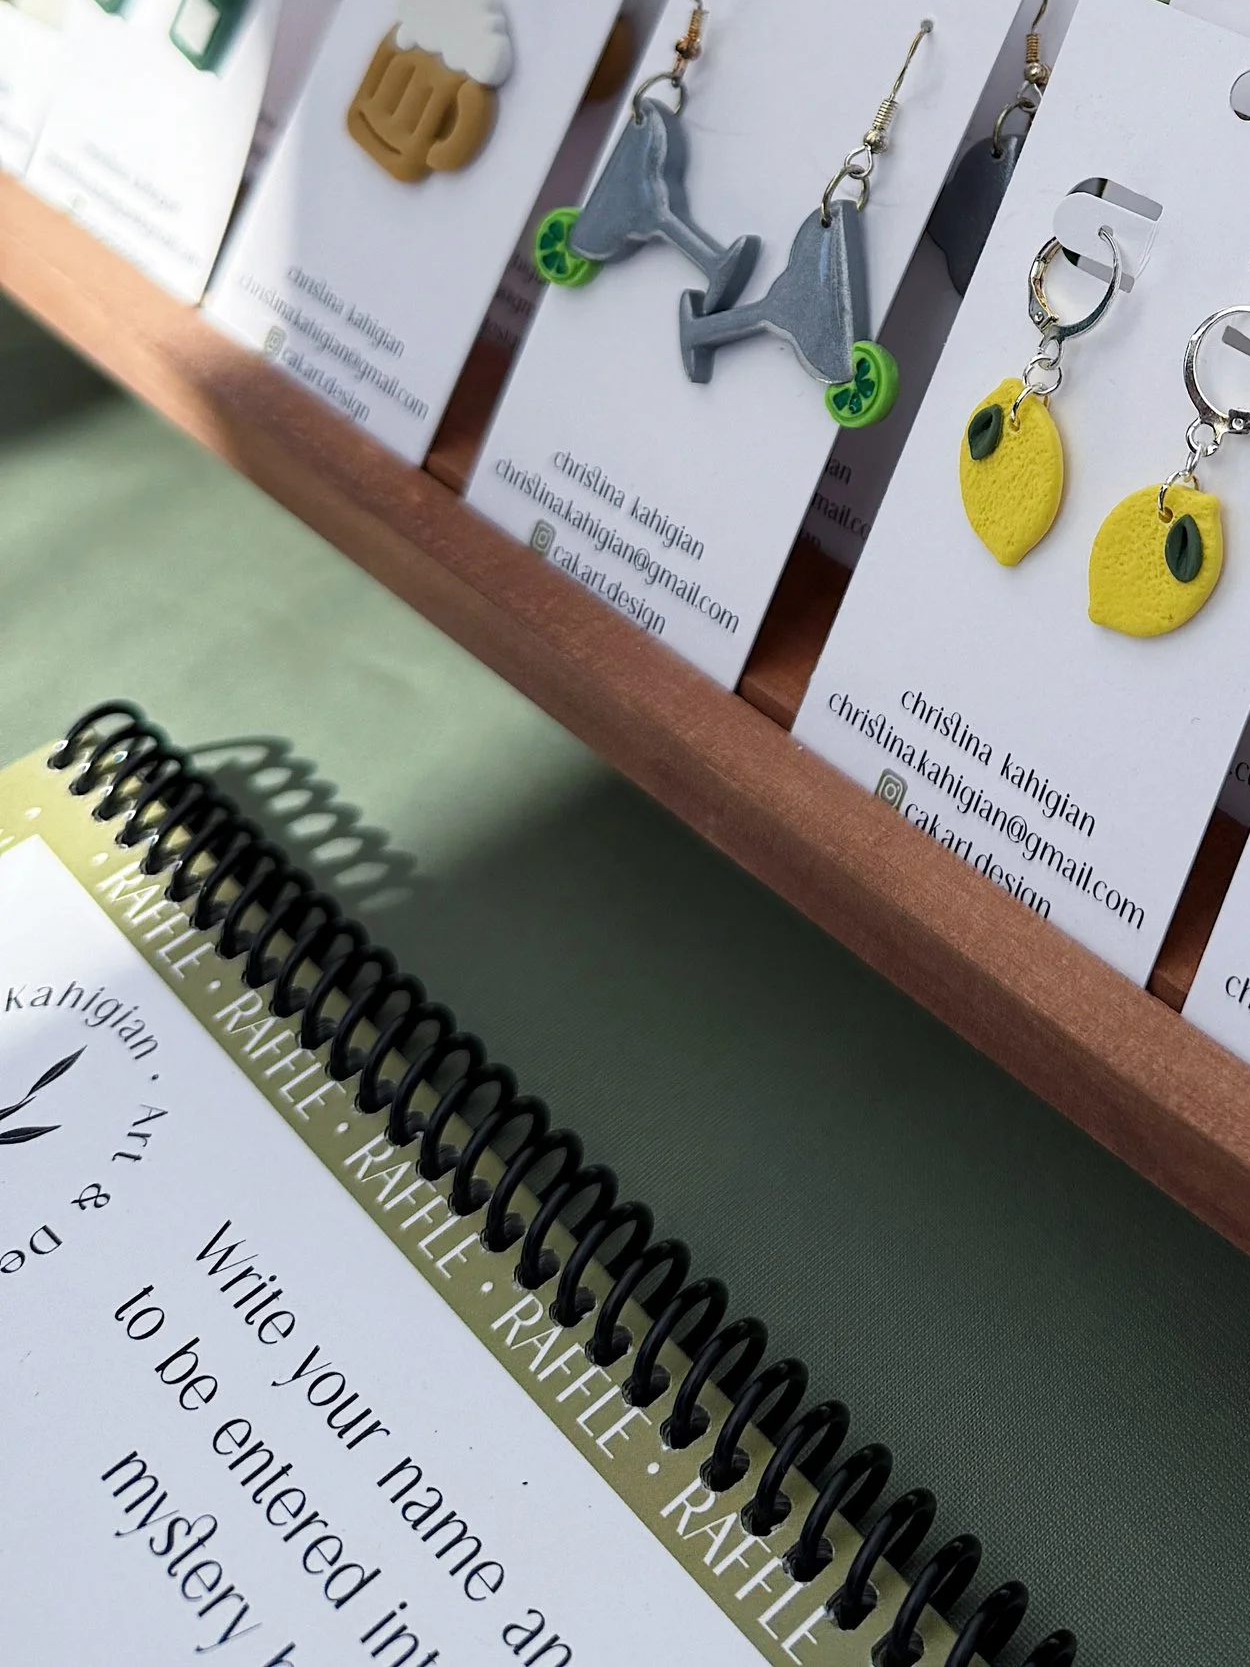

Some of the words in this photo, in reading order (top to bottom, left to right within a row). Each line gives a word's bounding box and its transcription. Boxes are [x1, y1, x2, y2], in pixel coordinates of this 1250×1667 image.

[553, 449, 626, 510] christina
[630, 495, 706, 561] kahigian
[828, 691, 1146, 930] christina.kahigian@gmail.com
[900, 688, 993, 766] christina
[1001, 752, 1096, 838] kahigian
[96, 861, 214, 980] RAFFLE
[215, 986, 347, 1122] RAFFLE
[70, 1182, 112, 1211] &
[112, 1103, 169, 1162] Art
[343, 1132, 482, 1280] RAFFLE
[114, 1283, 165, 1342] to
[155, 1336, 219, 1412] be
[212, 1416, 382, 1610] entered
[195, 1218, 297, 1346] Write
[271, 1344, 391, 1451] your
[377, 1455, 505, 1602] name
[491, 1294, 652, 1459] RAFFLE
[101, 1449, 263, 1655] mystery
[660, 1476, 827, 1666] RAFFLE
